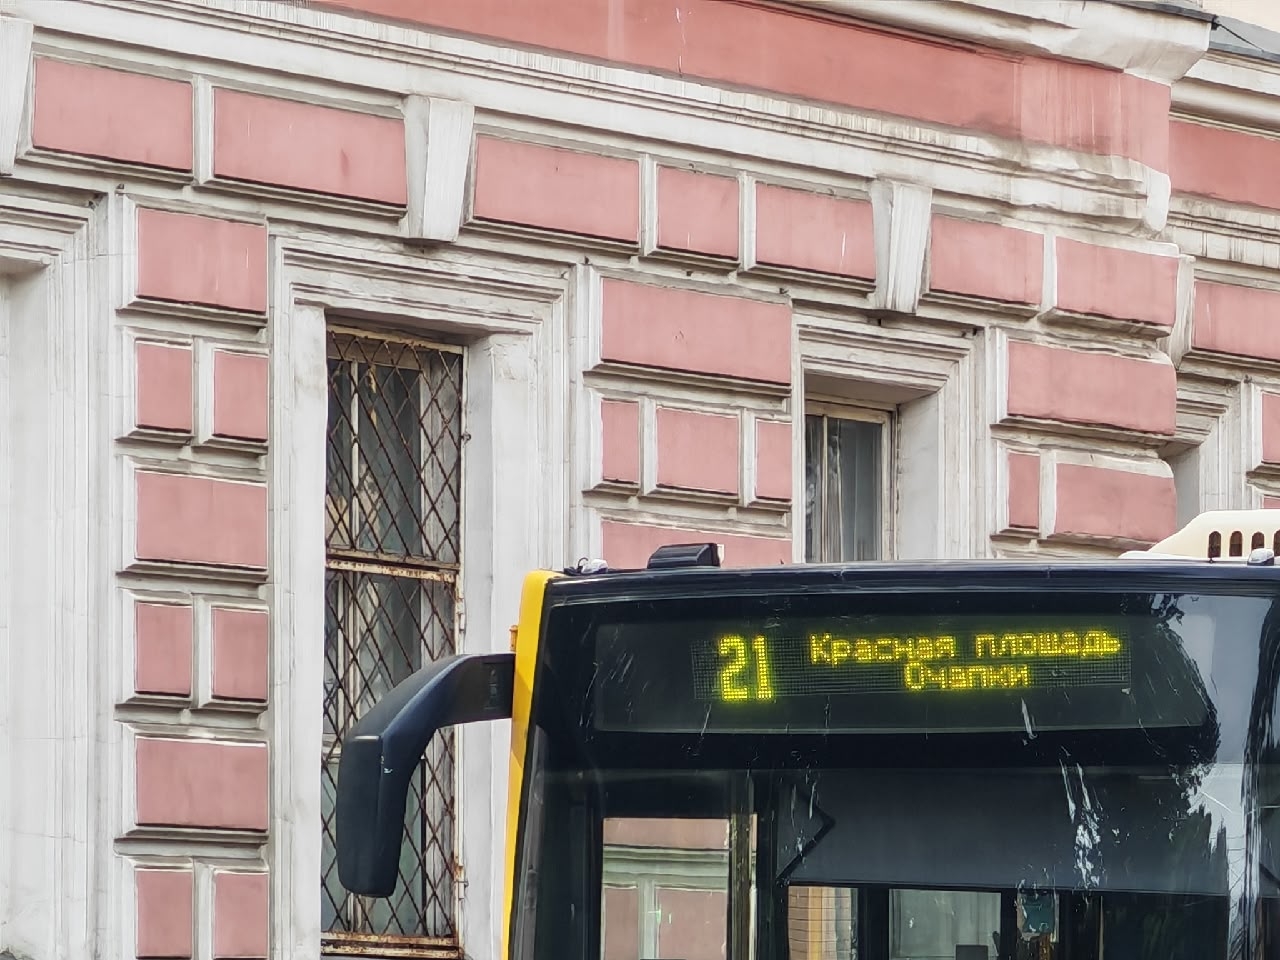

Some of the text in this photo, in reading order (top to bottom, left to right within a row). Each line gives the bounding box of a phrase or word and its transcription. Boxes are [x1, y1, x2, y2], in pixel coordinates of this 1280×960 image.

[810, 630, 1121, 667] Красная площадь
[719, 635, 773, 700] 21
[905, 661, 1030, 689] Очапки
